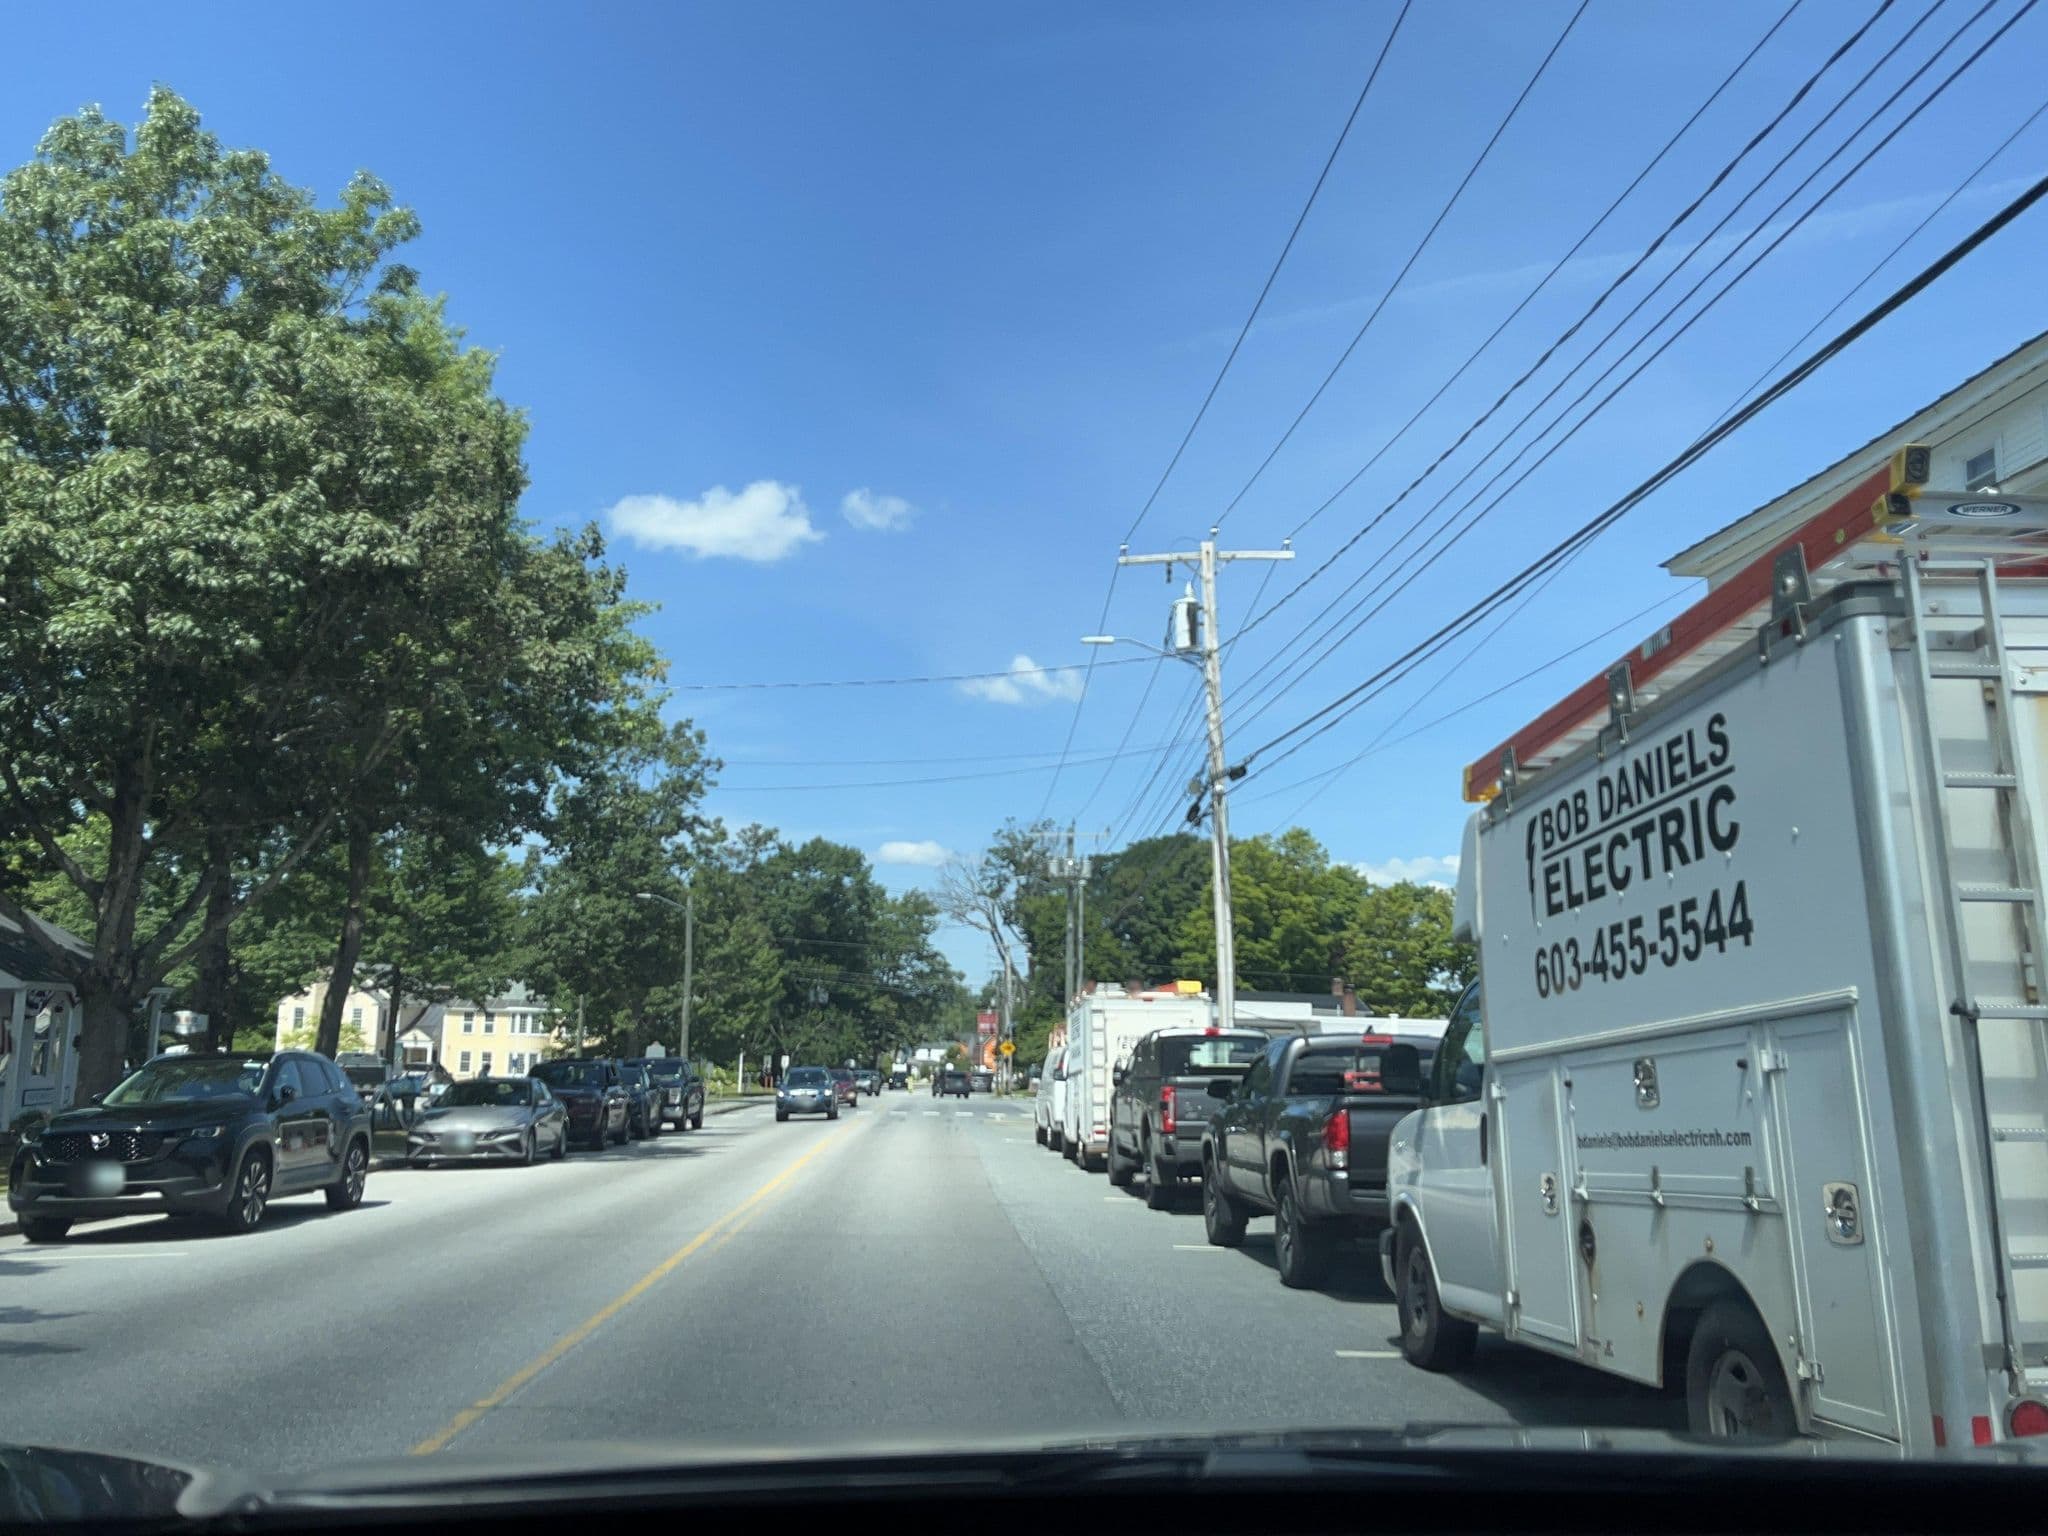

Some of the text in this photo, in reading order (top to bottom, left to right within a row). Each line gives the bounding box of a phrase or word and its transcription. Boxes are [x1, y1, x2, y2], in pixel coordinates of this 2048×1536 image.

[1962, 505, 2008, 513] WERNER
[1541, 712, 1730, 851] BOB DANIELS
[1543, 784, 1740, 917] ELECTRIC
[1535, 880, 1754, 998] 603-455-5544
